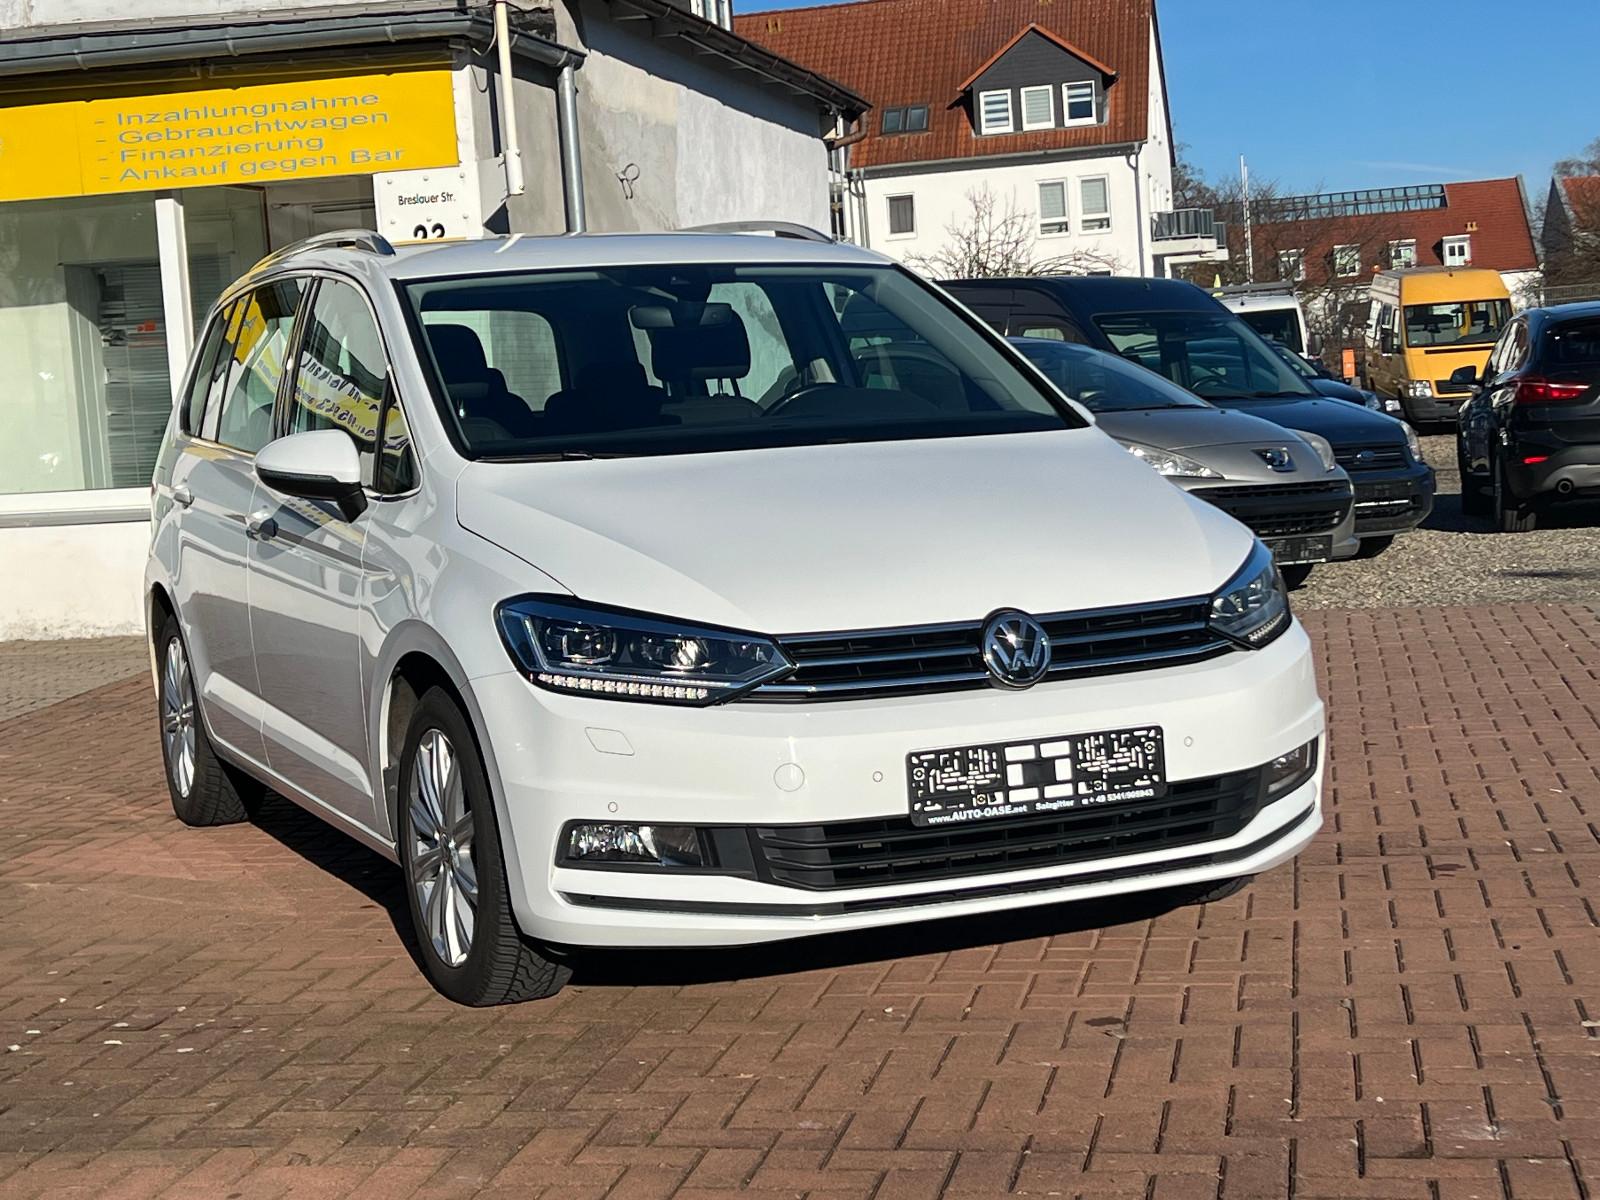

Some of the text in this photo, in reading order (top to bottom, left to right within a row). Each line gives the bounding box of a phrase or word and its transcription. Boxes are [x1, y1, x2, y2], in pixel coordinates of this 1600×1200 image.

[117, 94, 379, 126] Inzahlungnahme
[118, 112, 388, 144] Gebrauchtwagen
[120, 136, 324, 163] Finanzierung
[119, 160, 228, 182] Ankauf
[239, 153, 337, 175] gegen
[350, 149, 406, 164] Bar
[398, 191, 456, 206] Breslauer Str.
[1035, 799, 1075, 811] Salzgitter
